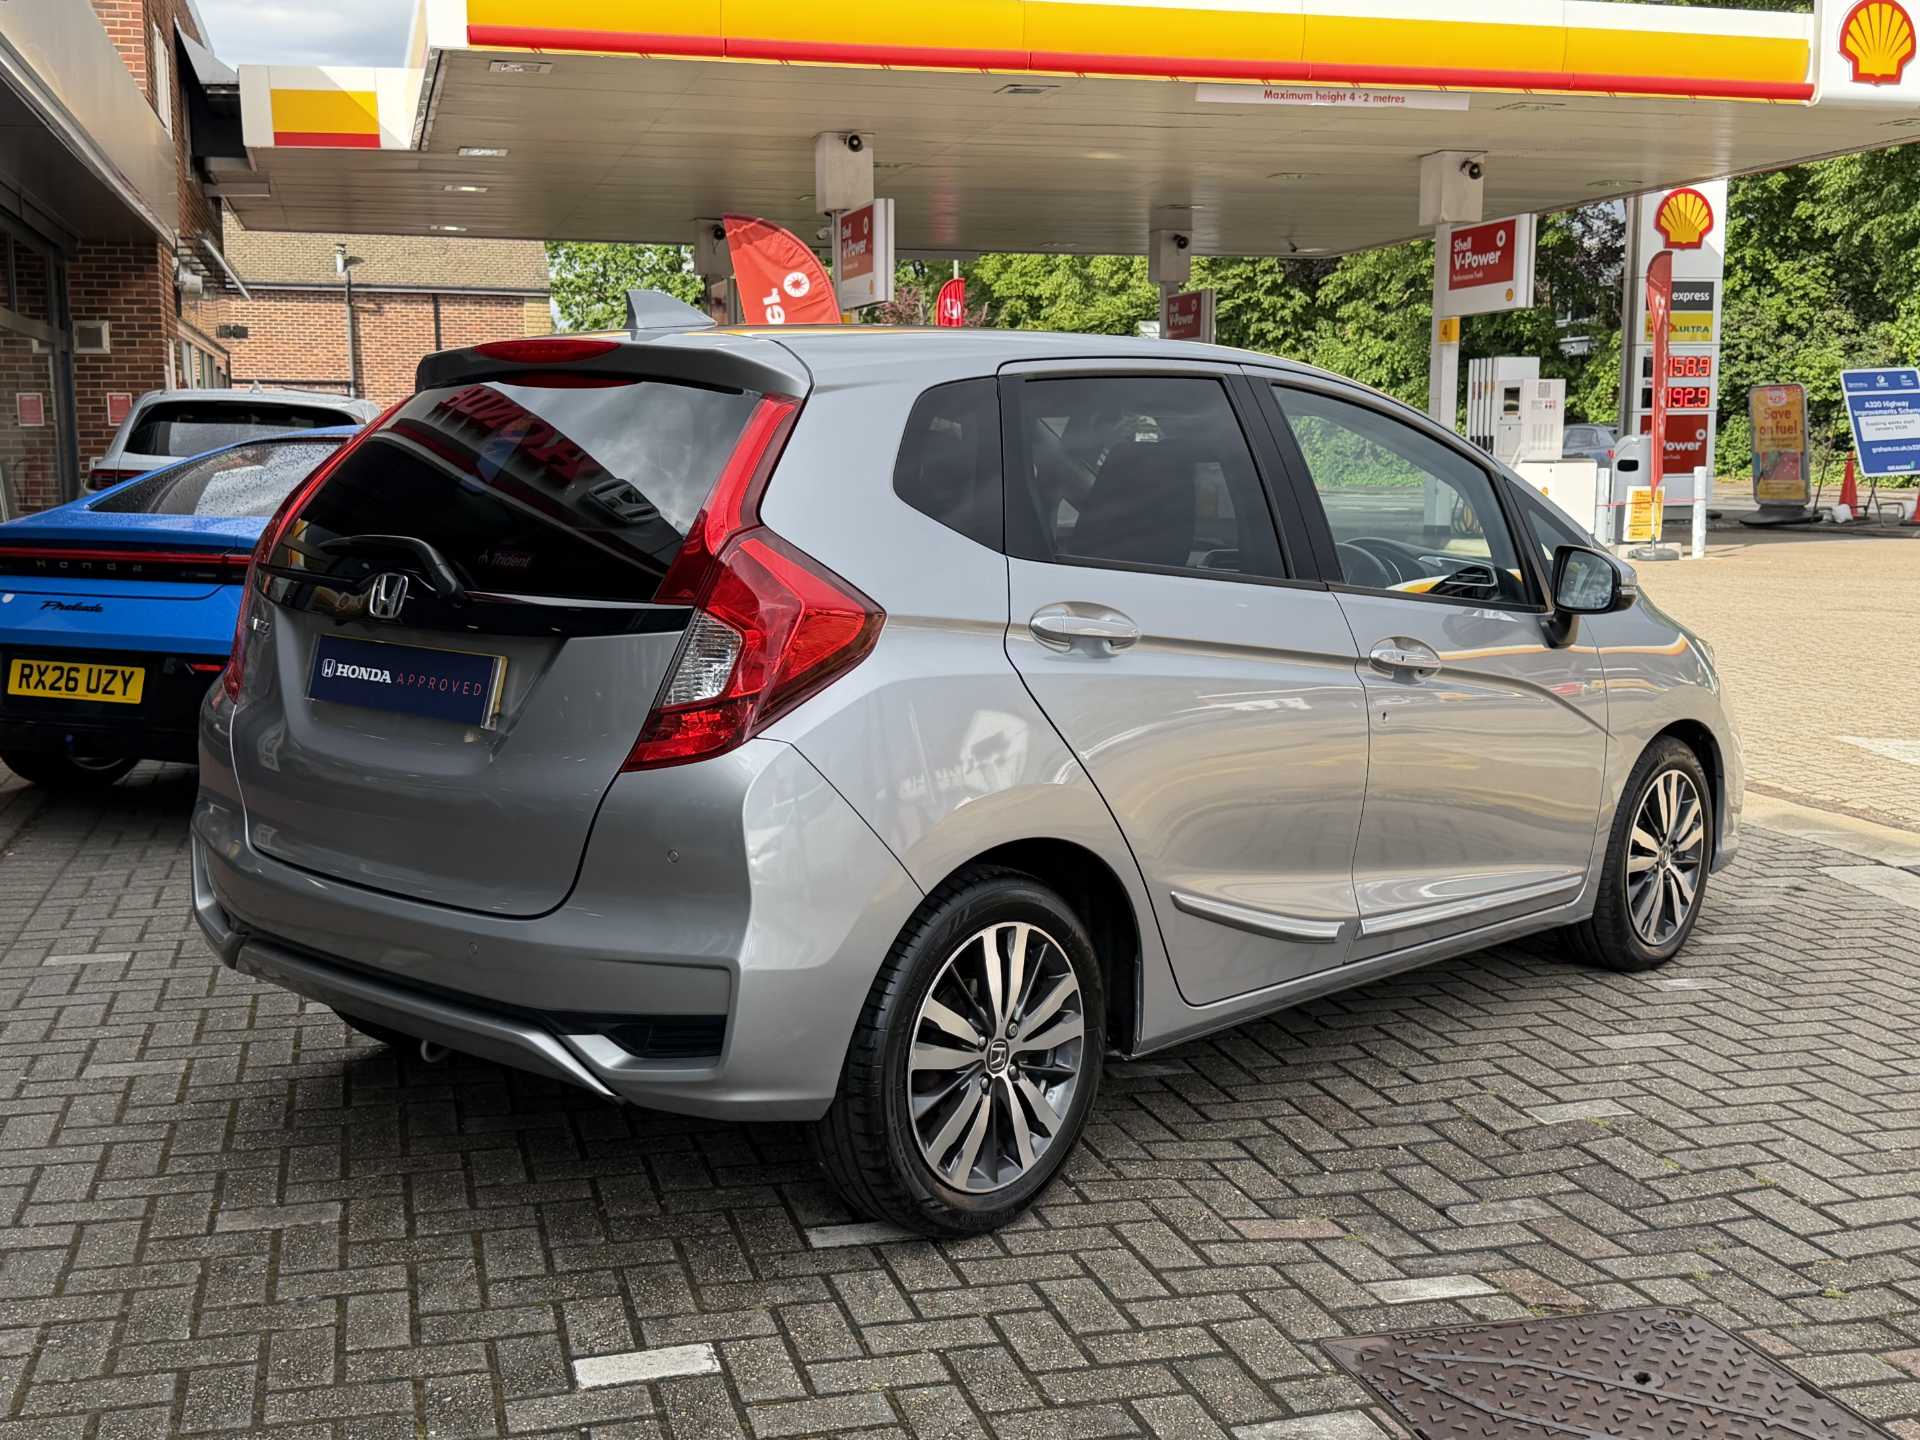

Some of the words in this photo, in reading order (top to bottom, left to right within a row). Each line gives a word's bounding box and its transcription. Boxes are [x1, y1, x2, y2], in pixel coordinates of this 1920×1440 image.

[1264, 90, 1313, 100] Maximum
[1315, 90, 1346, 103] height
[1373, 94, 1406, 103] metres
[1454, 236, 1472, 253] Shell
[1454, 251, 1501, 270] V-Power
[1672, 291, 1710, 303] express
[1442, 324, 1449, 339] 4
[1669, 356, 1710, 377] 158.9
[1667, 388, 1709, 408] 192.9
[1764, 408, 1792, 419] Save
[1760, 425, 1774, 436] on
[1776, 420, 1798, 435] fuel
[40, 600, 104, 612] Prelude
[18, 663, 80, 692] RX26
[86, 668, 135, 696] UZY
[336, 663, 392, 684] HONDA
[396, 672, 483, 697] APPROVED
